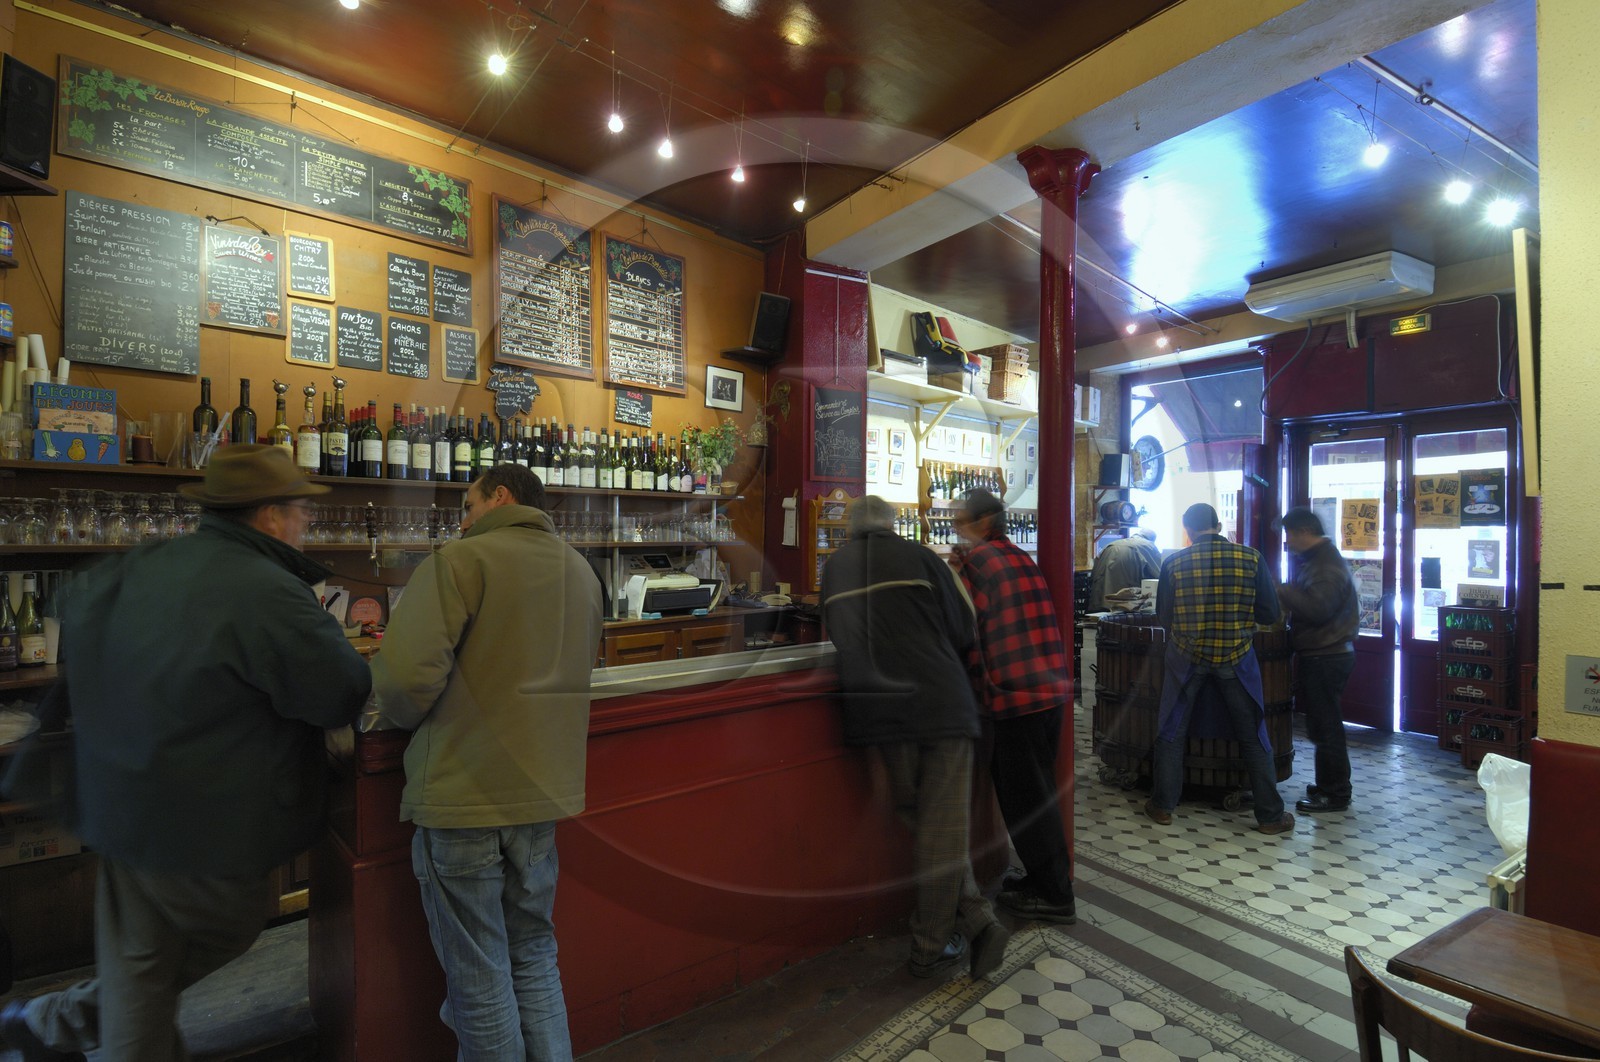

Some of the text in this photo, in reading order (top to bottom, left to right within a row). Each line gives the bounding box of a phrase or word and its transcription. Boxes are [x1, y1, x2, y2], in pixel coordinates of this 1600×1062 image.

[121, 208, 171, 226] PRESSION
[294, 244, 322, 255] CHITRY
[341, 312, 374, 325] ANJOU
[390, 321, 421, 335] CAHORS
[449, 331, 473, 341] ALSACE
[99, 337, 157, 354] DIVERS
[36, 398, 62, 409] DES
